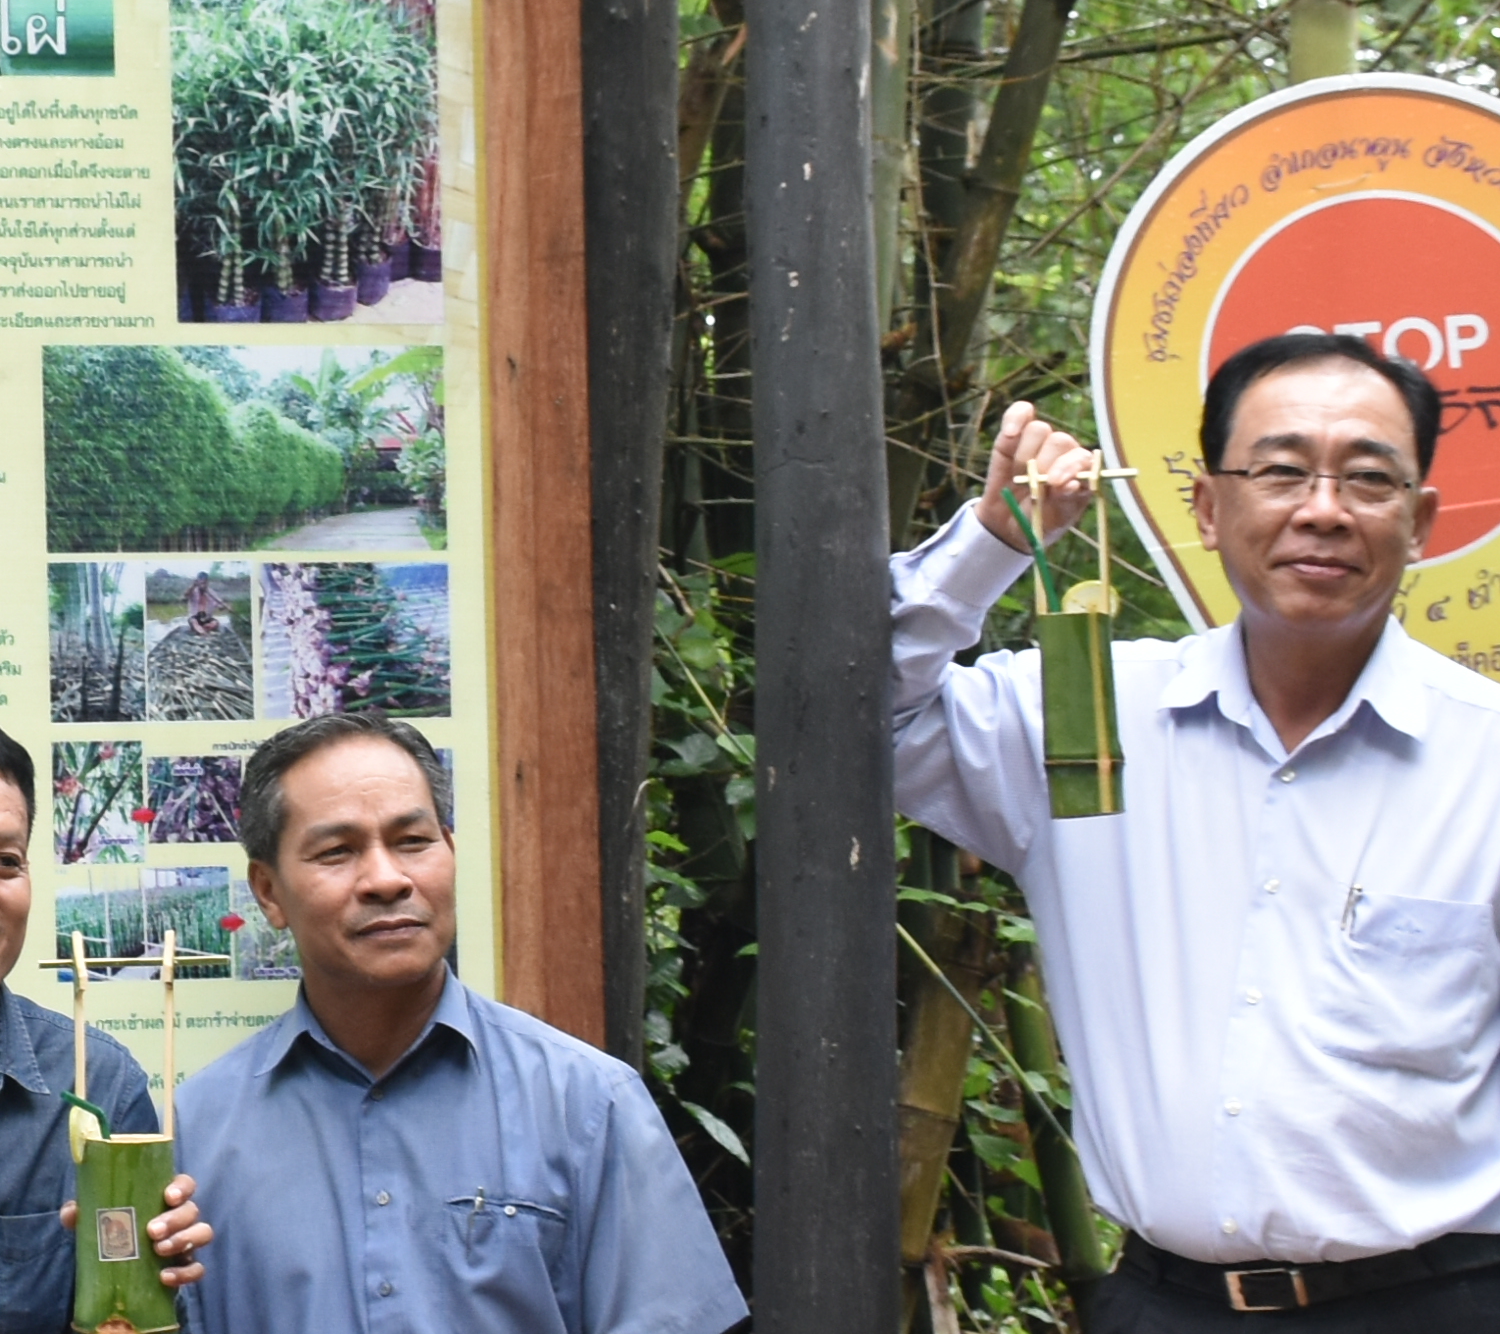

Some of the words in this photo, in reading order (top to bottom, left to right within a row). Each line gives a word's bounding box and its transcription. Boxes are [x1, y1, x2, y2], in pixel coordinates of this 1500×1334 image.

[1260, 136, 1414, 192] อำเภอนาดูน
[1283, 312, 1490, 371] TOP
